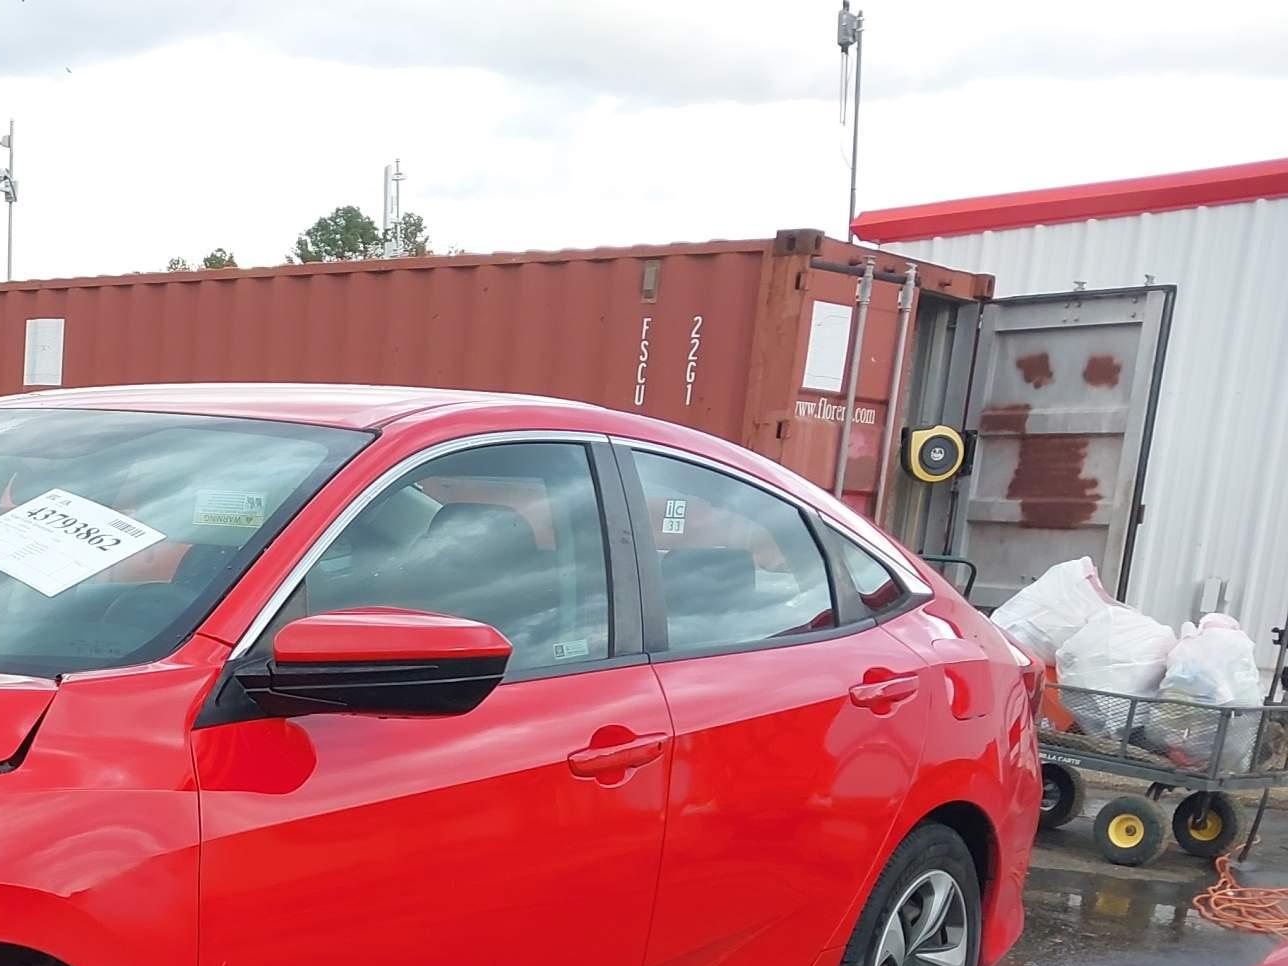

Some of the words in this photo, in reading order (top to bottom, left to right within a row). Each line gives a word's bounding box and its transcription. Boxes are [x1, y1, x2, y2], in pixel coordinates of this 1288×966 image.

[634, 317, 652, 406] FSCU
[685, 315, 703, 406] 22G1
[26, 506, 122, 552] 43793862
